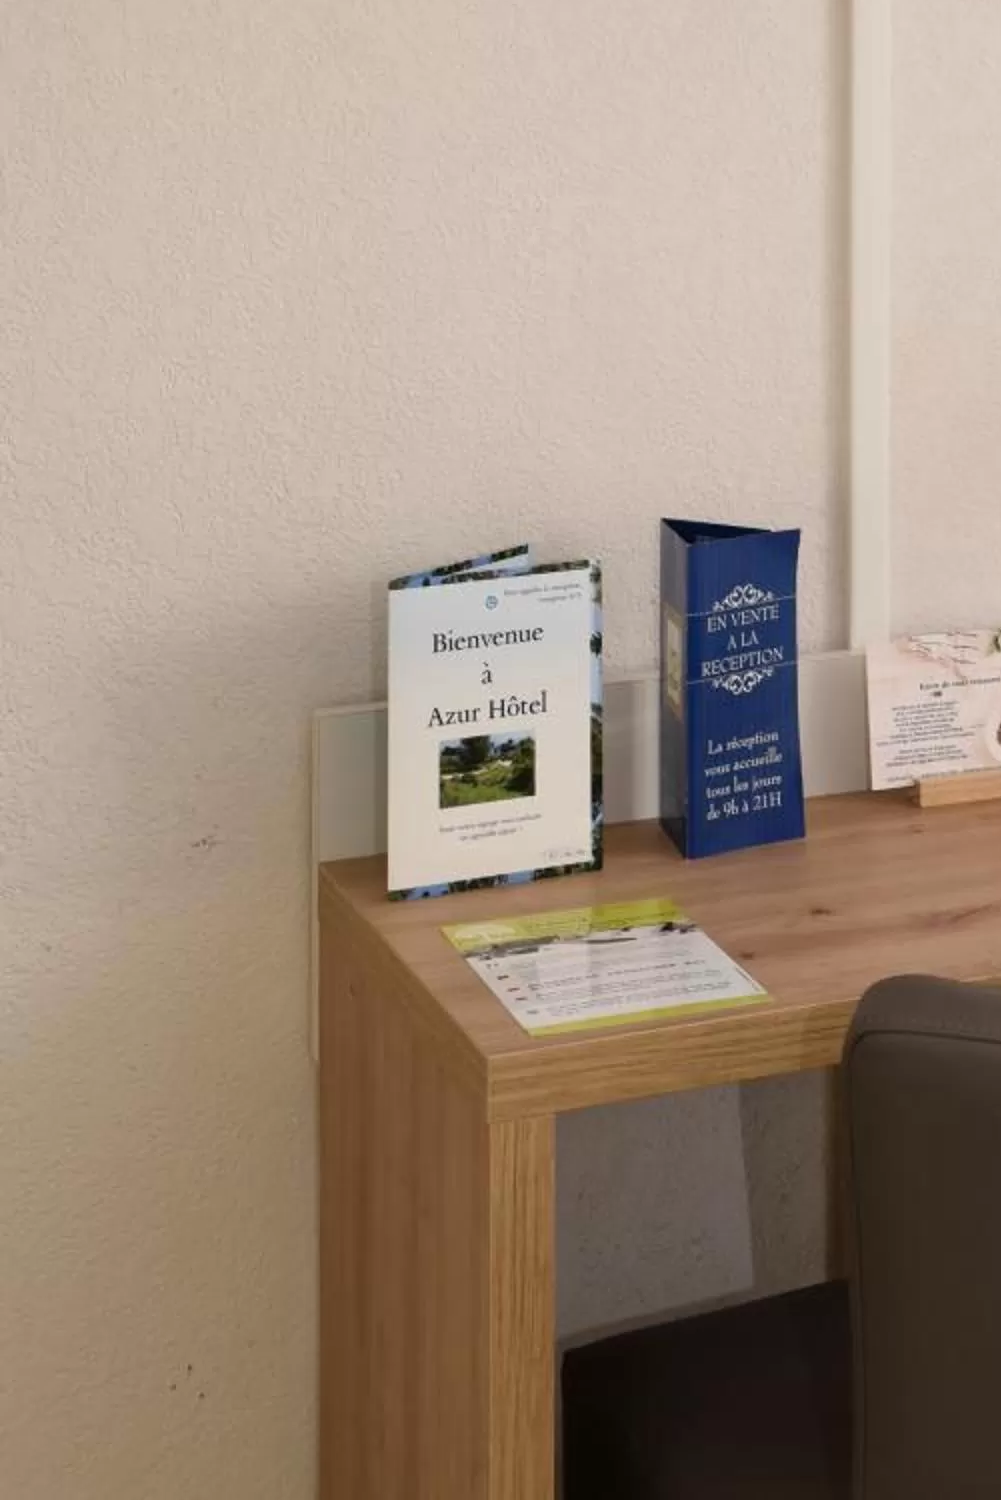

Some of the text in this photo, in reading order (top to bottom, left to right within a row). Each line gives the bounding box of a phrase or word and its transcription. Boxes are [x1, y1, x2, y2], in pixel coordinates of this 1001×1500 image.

[707, 603, 780, 633] EN VENTE
[432, 626, 545, 654] Bienvenue
[727, 629, 759, 651] A LA
[481, 660, 493, 685] à
[701, 645, 784, 677] RECEPTION
[428, 689, 547, 728] Azur Hôtel
[708, 732, 779, 755] La réception
[704, 746, 783, 777] vous accueille
[706, 775, 782, 799] tous les jours
[707, 791, 782, 821] de 9h à 21H
